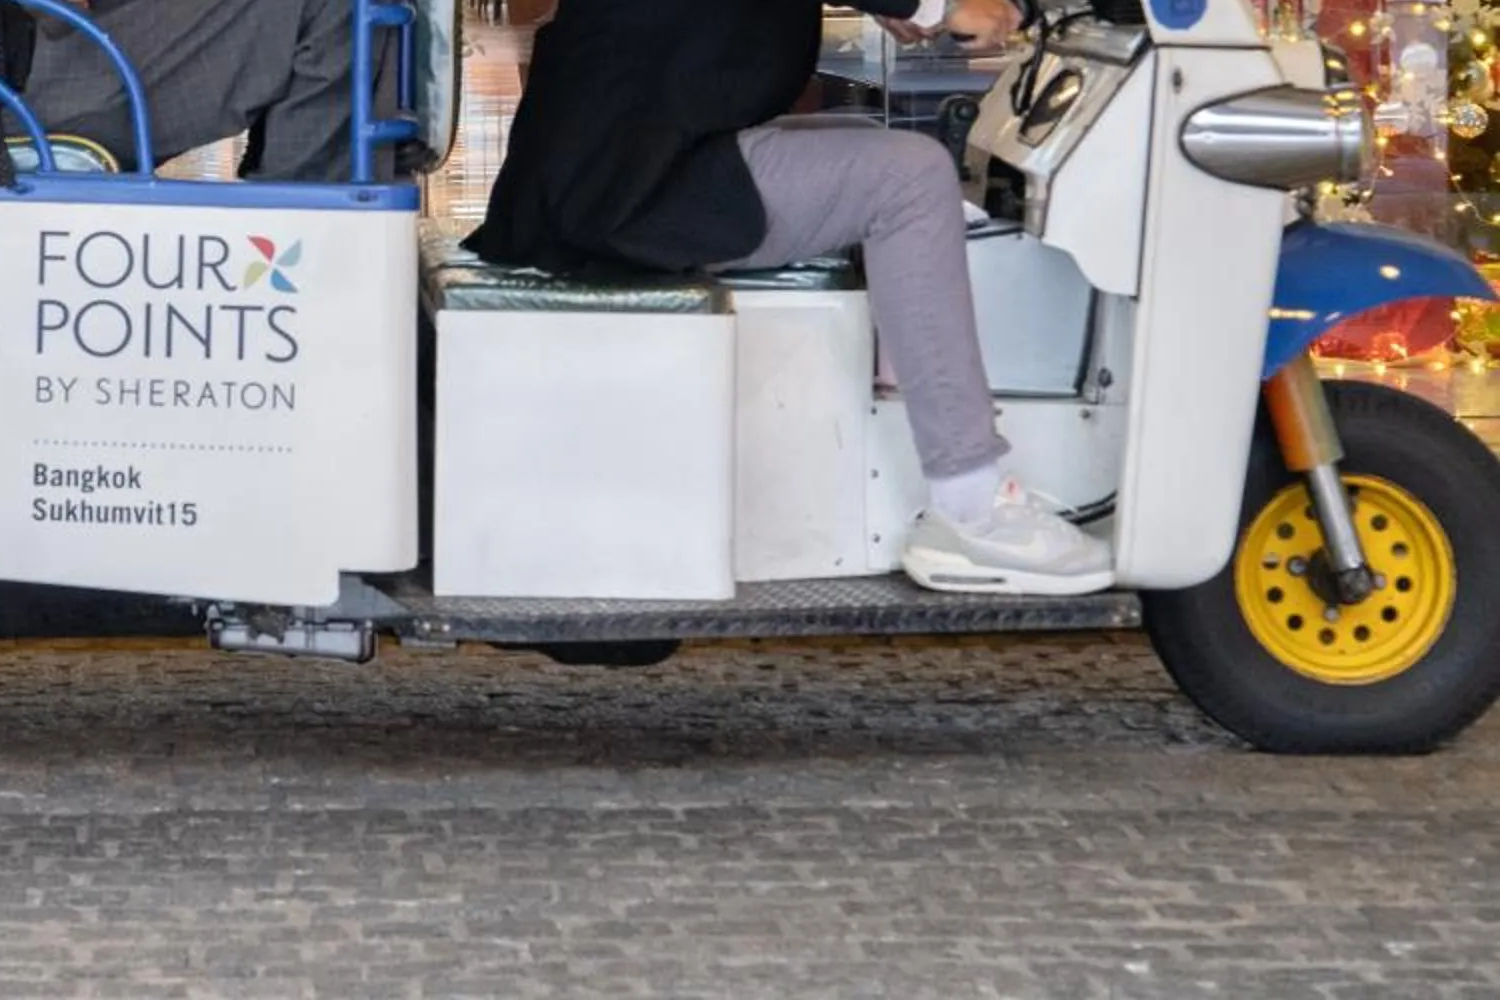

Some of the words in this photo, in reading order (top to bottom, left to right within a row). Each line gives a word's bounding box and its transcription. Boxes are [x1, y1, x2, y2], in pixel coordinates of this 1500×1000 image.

[38, 230, 237, 292] FOUR
[36, 299, 299, 363] POINTS
[35, 375, 78, 404] BY
[95, 377, 296, 410] SHERATON
[33, 462, 141, 493] Bangkok
[32, 497, 198, 526] Sukhumvit15
